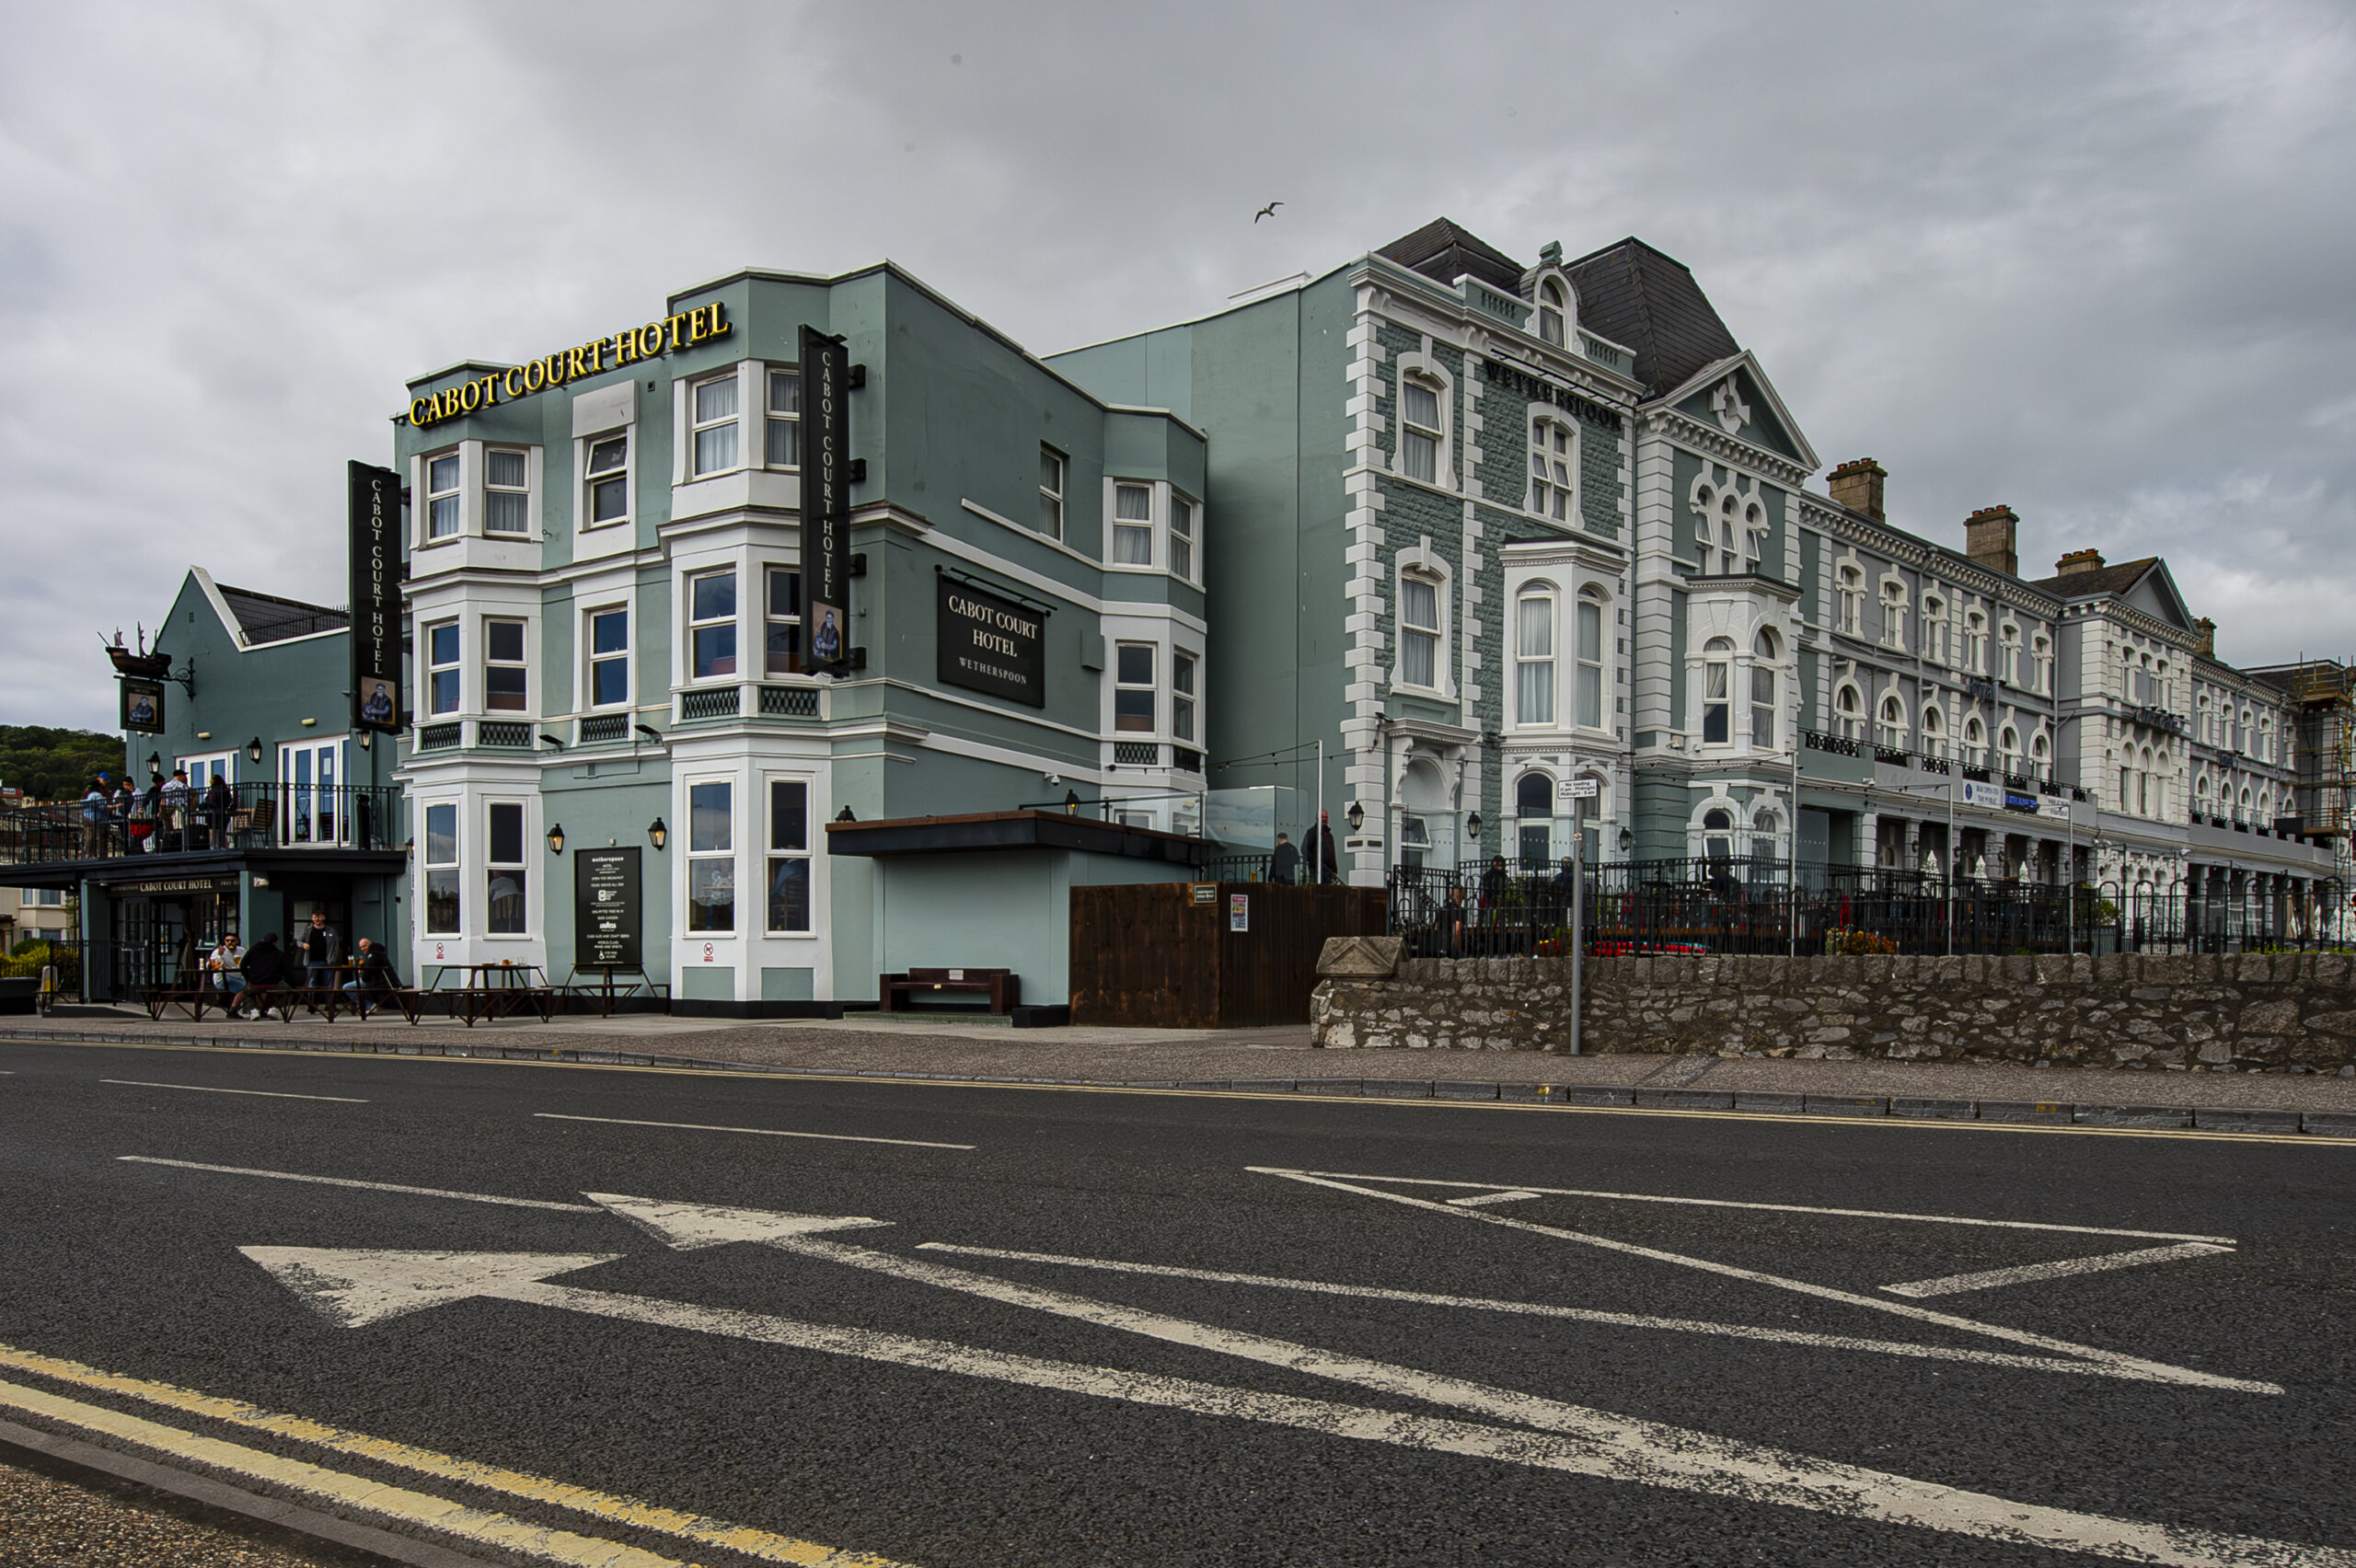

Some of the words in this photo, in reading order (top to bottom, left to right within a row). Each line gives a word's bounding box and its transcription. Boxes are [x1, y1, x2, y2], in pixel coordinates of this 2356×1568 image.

[410, 372, 501, 427] CABOT
[505, 338, 609, 398] COURT
[615, 301, 733, 366] HOTEL
[822, 352, 832, 429] CABOT
[1485, 357, 1622, 432] WETHERSPOON
[823, 436, 833, 514] COURT
[371, 479, 382, 541] CABOT
[372, 546, 383, 607] COURT
[823, 520, 833, 599] HOTEL
[372, 612, 383, 674] HOTEL
[949, 594, 994, 625] CABOT
[996, 612, 1038, 640] COURT
[973, 628, 1018, 658] HOTEL
[959, 656, 1027, 685] WETHERSPOON
[140, 882, 162, 892] CABOT
[164, 881, 187, 892] COURT
[189, 880, 213, 889] HOTEL
